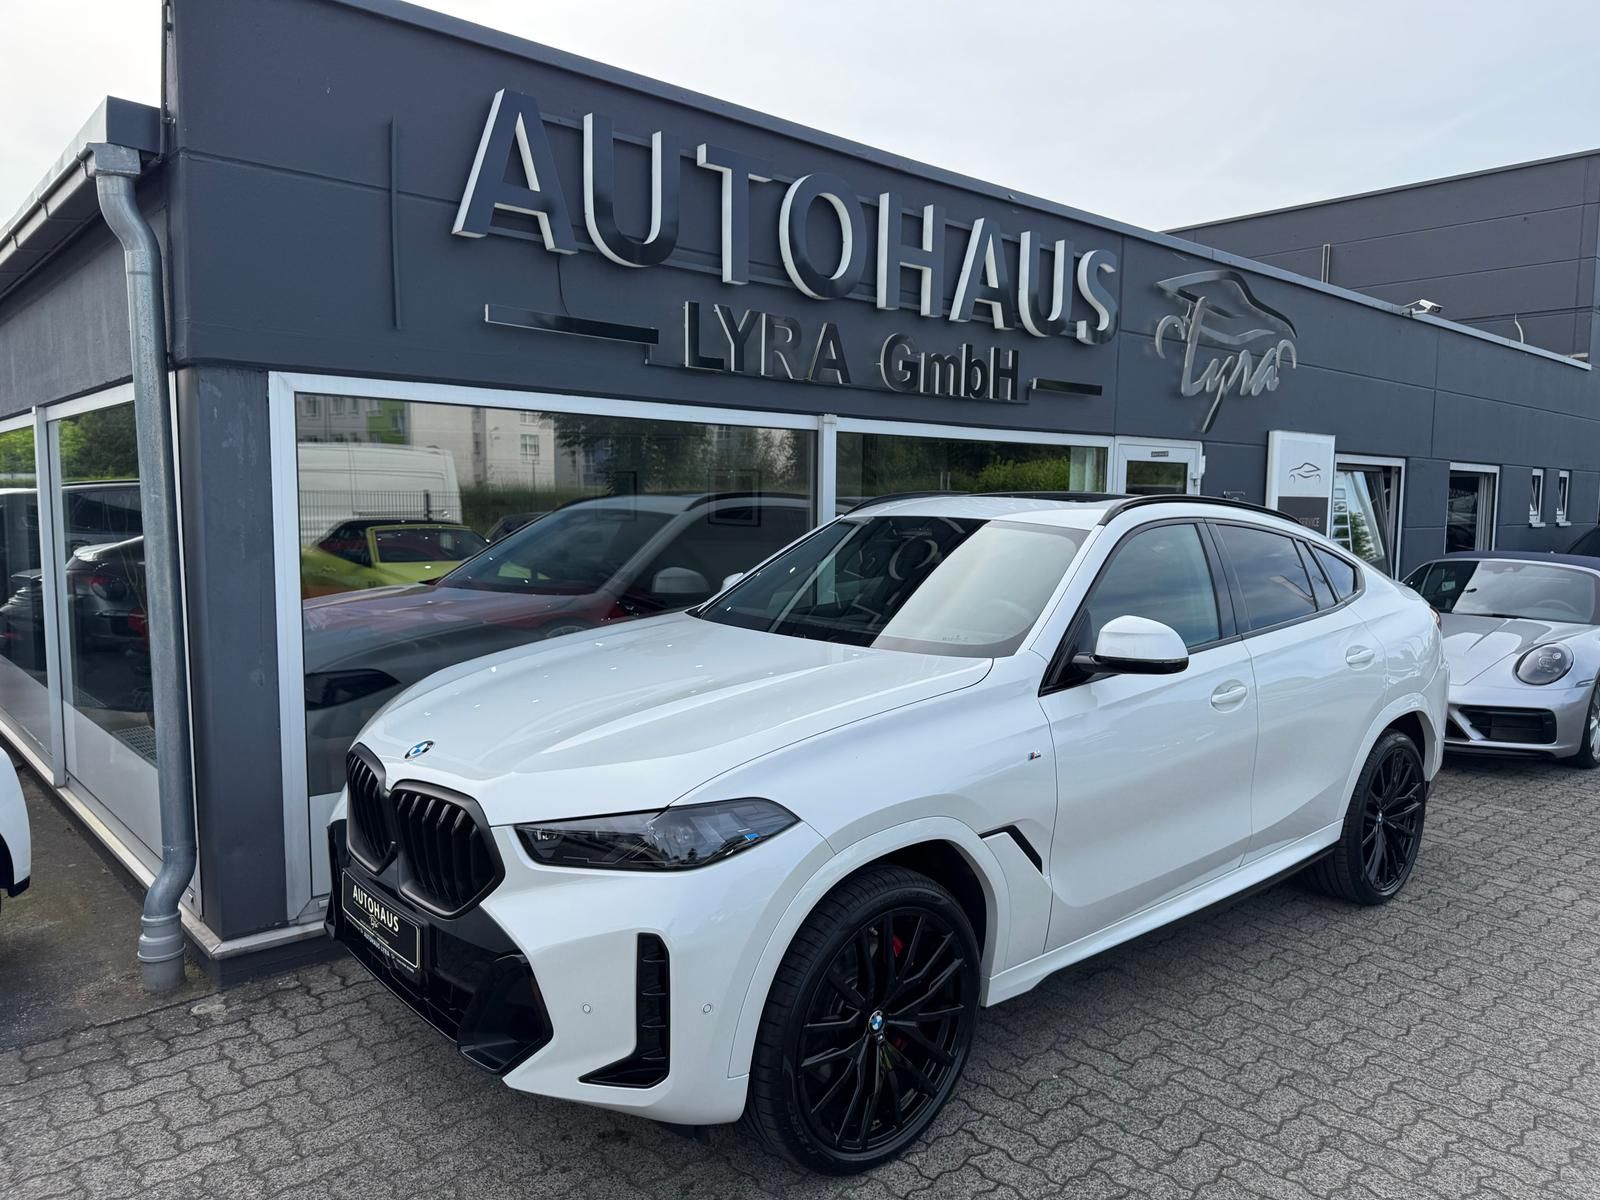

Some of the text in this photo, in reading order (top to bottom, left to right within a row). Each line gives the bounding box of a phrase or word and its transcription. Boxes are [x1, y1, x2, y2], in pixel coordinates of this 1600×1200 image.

[452, 88, 1118, 345] AUTOHAUS
[683, 300, 1020, 401] LYRA GmbH
[352, 884, 399, 932] AUTOHAUS
